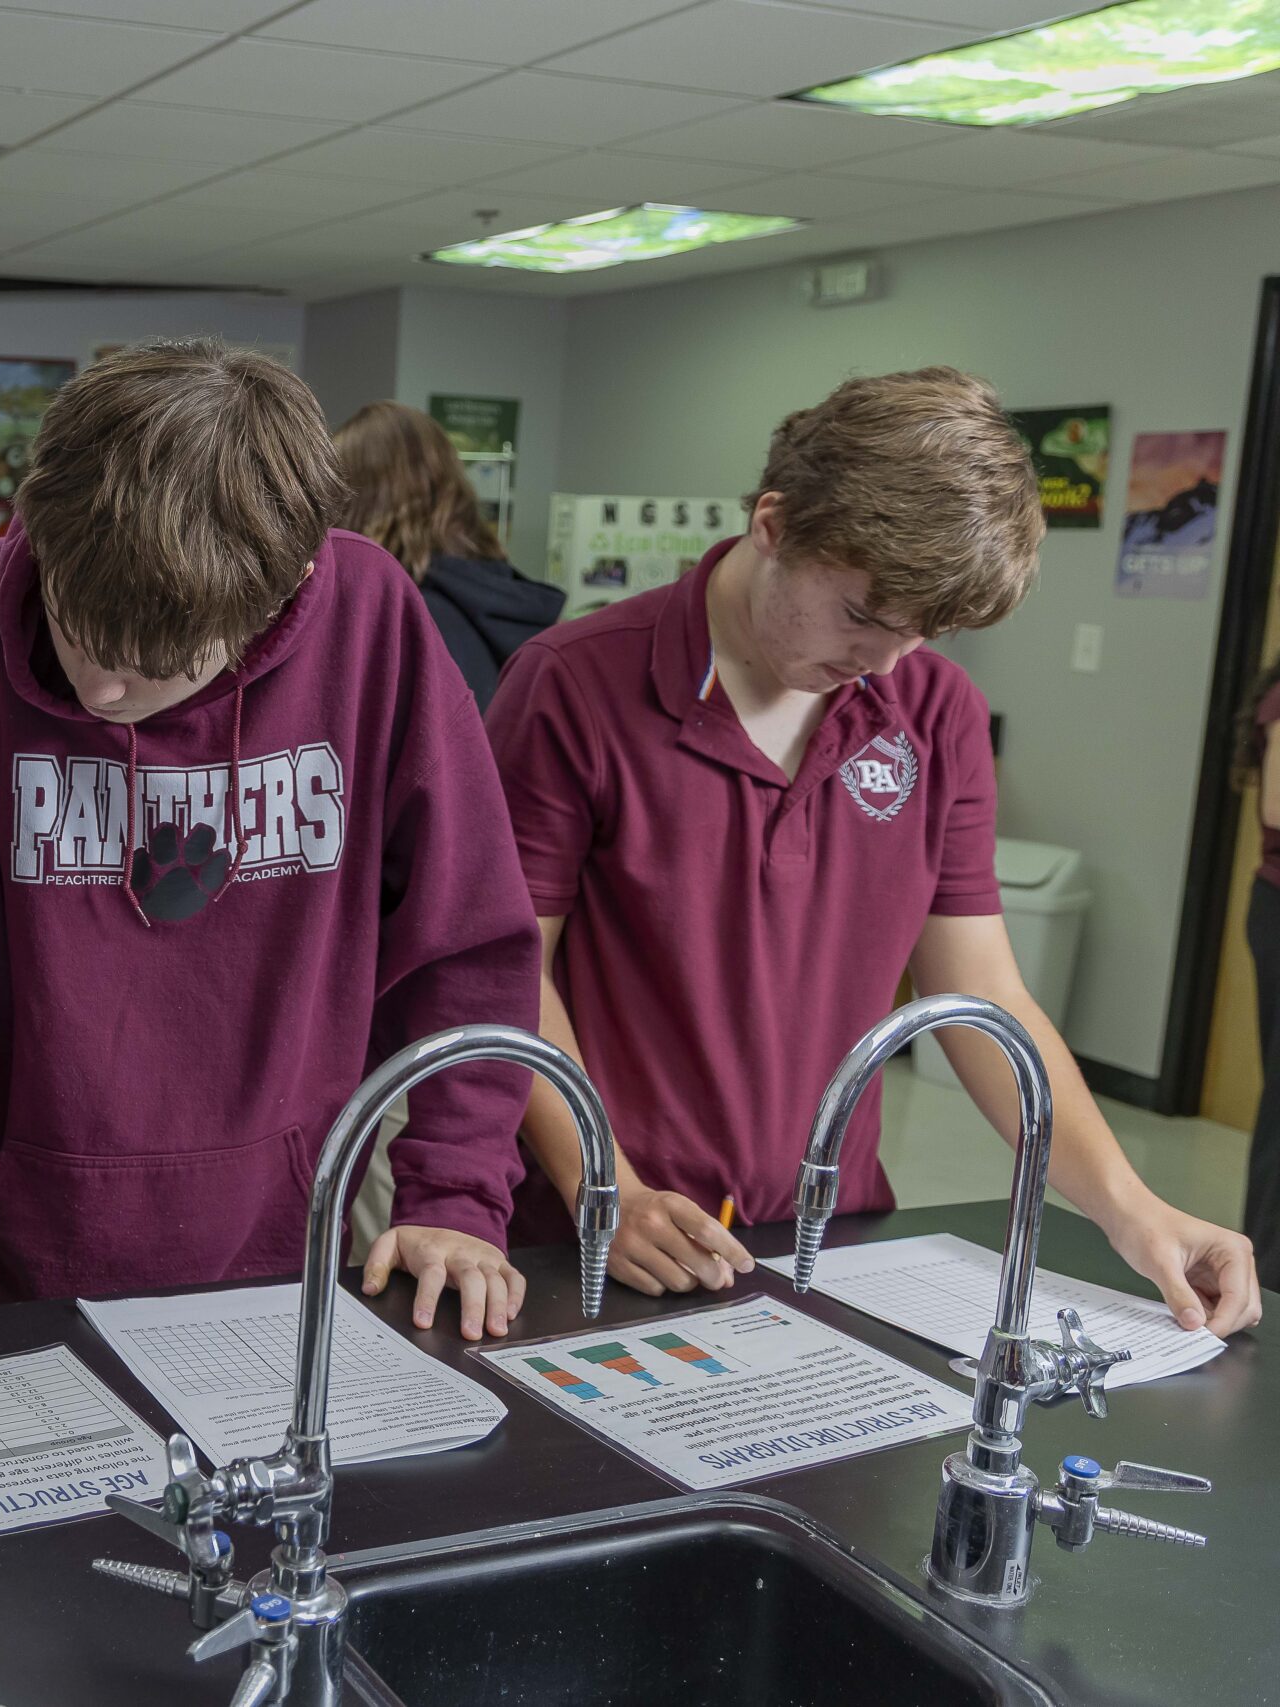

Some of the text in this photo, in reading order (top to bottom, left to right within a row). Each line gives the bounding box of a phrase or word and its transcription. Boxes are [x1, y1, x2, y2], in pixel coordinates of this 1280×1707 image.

[855, 760, 901, 793] PA
[12, 741, 345, 884] PANTHERS
[232, 865, 301, 883] ACADEMY
[812, 1351, 856, 1365] pyramids,
[834, 1358, 872, 1372] (beyond
[773, 1367, 801, 1377] visual
[780, 1369, 836, 1384] reproductive
[836, 1374, 858, 1382] that
[706, 1373, 775, 1389] representations
[757, 1381, 782, 1390] age).
[815, 1379, 839, 1387] they
[843, 1374, 900, 1391] reproductive
[891, 1381, 915, 1390] each
[697, 1390, 741, 1401] structure
[747, 1388, 801, 1402] reproduce),
[795, 1395, 815, 1404] and
[811, 1387, 847, 1399] (young
[849, 1390, 877, 1400] group
[871, 1393, 912, 1406] structure
[618, 1396, 662, 1408] structure
[650, 1398, 698, 1411] diagrams,
[730, 1398, 751, 1406] and
[782, 1401, 834, 1415] population.
[648, 1401, 732, 1423] post-reproductive
[717, 1403, 780, 1419] reproducing),
[829, 1403, 872, 1417] describes
[658, 1415, 720, 1432] reproductive
[734, 1413, 784, 1426] Organisms
[777, 1417, 815, 1428] number
[642, 1428, 661, 1436] (at
[683, 1429, 704, 1437] pre-
[698, 1401, 947, 1469] AGE STRUCTURE DIAGRAMS
[715, 1427, 769, 1442] individuals
[112, 1437, 134, 1446] will
[684, 1439, 718, 1449] within
[65, 1445, 94, 1455] used
[97, 1445, 143, 1458] females
[31, 1457, 82, 1472] different
[129, 1454, 154, 1463] The
[1074, 1458, 1090, 1470] GAS
[7, 1468, 29, 1476] age
[73, 1459, 129, 1474] following
[45, 1470, 72, 1479] data
[98, 1469, 148, 1492] AGE
[259, 1599, 283, 1611] GAS
